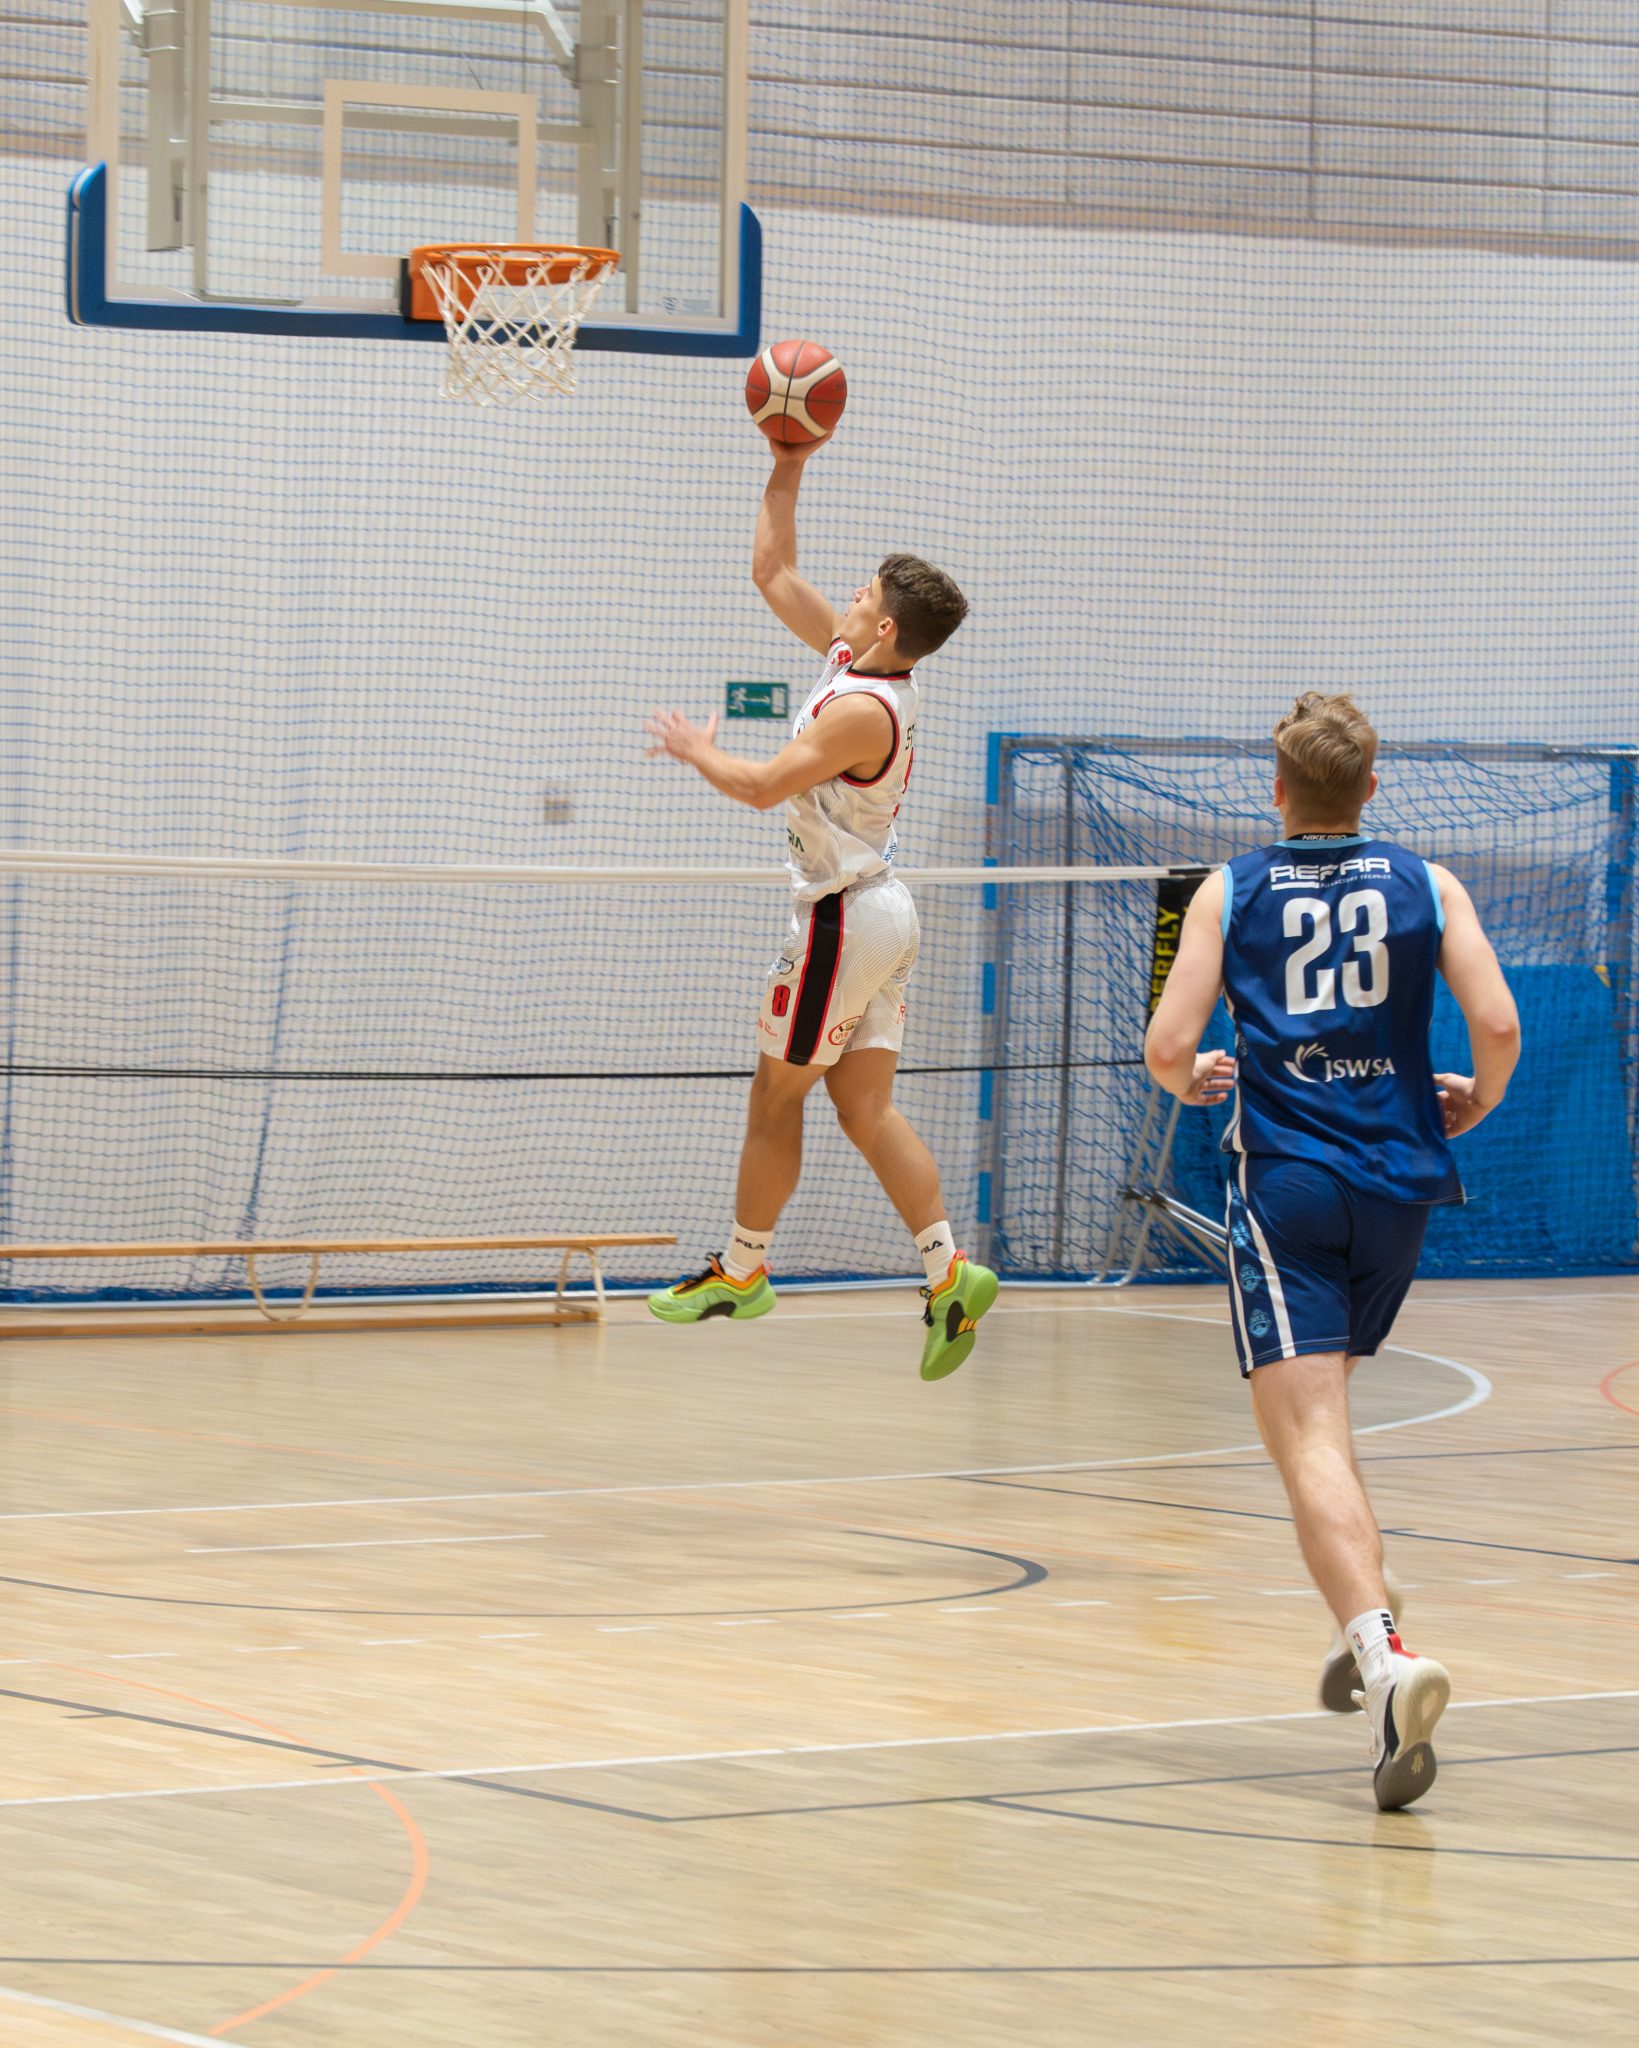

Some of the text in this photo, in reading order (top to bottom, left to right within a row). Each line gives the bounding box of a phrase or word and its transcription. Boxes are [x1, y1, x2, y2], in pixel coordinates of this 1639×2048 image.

[1269, 857, 1391, 883] REFRA
[1282, 888, 1390, 1015] 23
[772, 984, 790, 1017] 8
